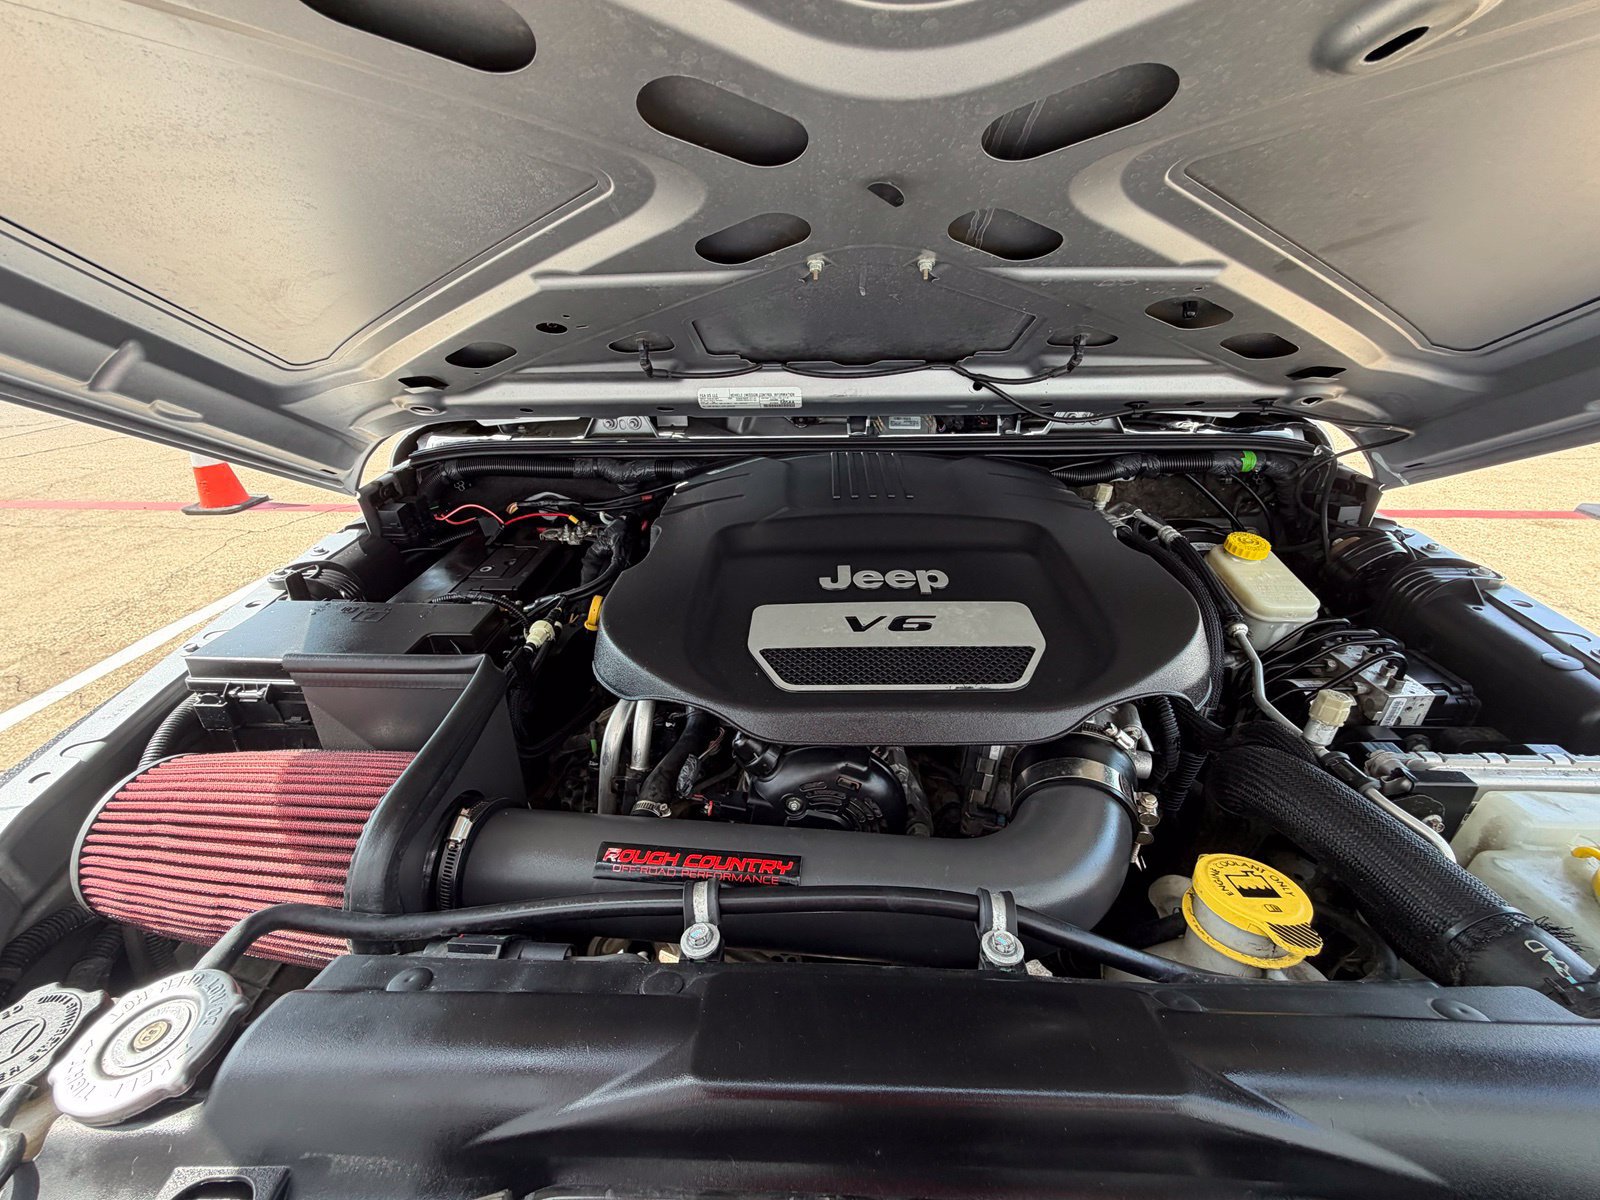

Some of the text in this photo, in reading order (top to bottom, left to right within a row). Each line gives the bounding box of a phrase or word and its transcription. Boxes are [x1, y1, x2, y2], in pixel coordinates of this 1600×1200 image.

[818, 565, 949, 595] Jeep
[845, 615, 936, 632] V6
[603, 847, 794, 875] ROUGH COUNTRY
[612, 864, 779, 885] OFF-ROAD PERFORMANCE
[1213, 861, 1265, 873] COOLANT
[1270, 874, 1296, 897] ONLY
